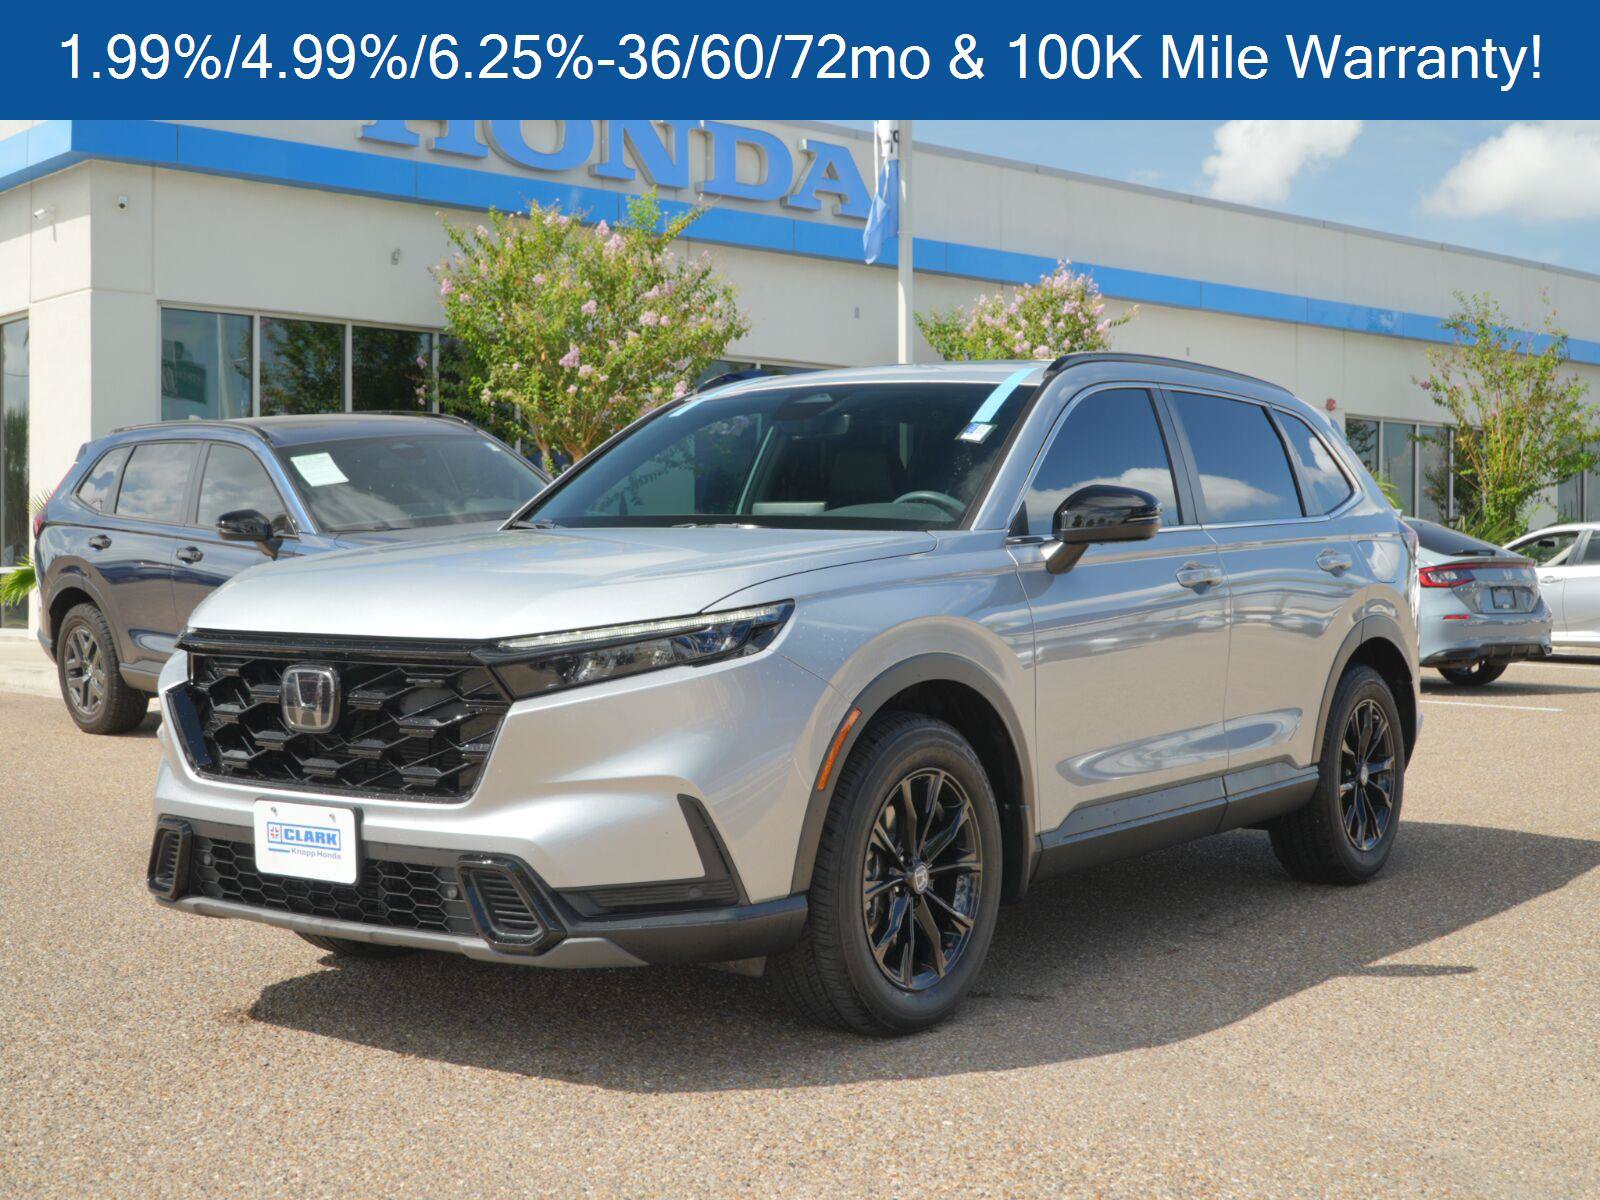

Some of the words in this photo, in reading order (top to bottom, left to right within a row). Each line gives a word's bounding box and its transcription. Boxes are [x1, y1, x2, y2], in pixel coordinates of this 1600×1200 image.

[284, 828, 337, 845] CLARK
[291, 847, 316, 858] Knapp
[317, 850, 342, 860] Honda
